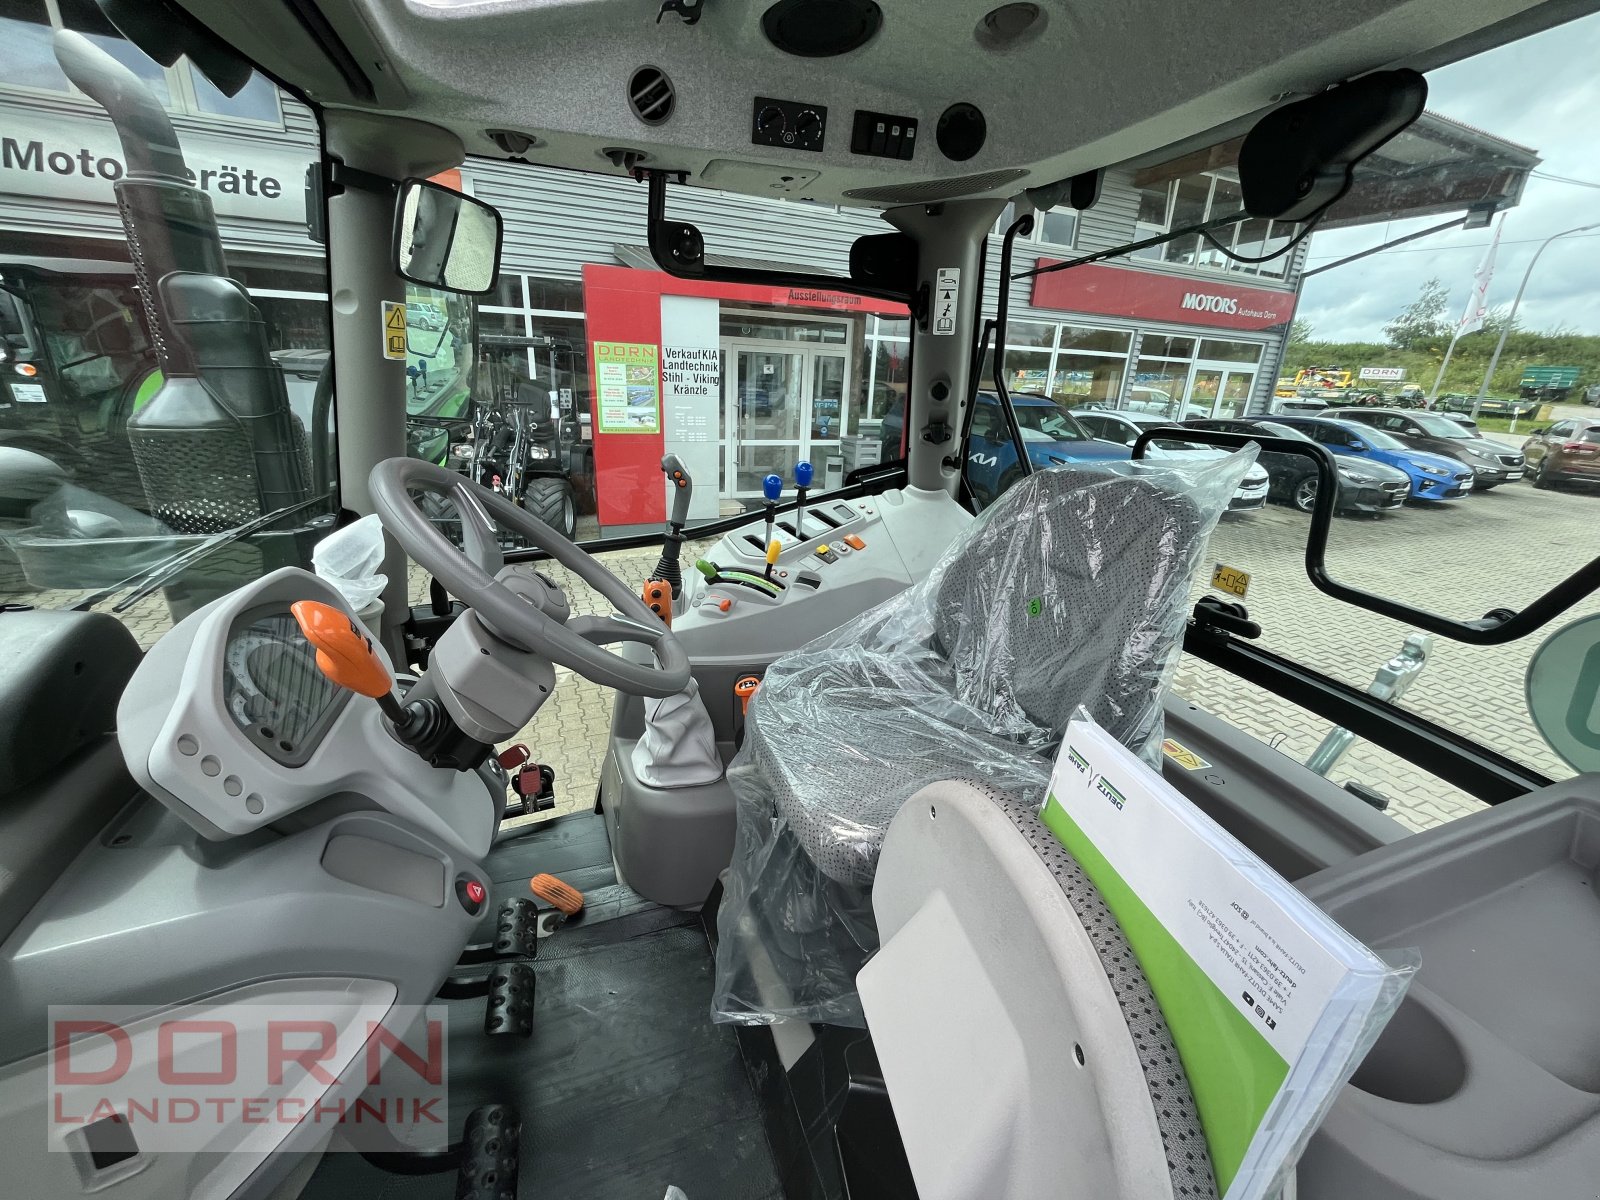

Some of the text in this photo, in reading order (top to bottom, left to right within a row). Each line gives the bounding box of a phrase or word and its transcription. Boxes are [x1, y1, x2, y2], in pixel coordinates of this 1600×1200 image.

[2, 137, 281, 199] Motoräte
[788, 289, 862, 305] Ausstellungsraum
[1181, 293, 1277, 319] MOTORS Autohaus Dorn
[599, 345, 654, 357] DORN
[665, 348, 718, 360] Verkauf KIA
[662, 359, 718, 372] Landtechnik
[1363, 368, 1399, 376] DORN
[662, 371, 683, 383] Stihl
[693, 373, 720, 387] Viking
[673, 384, 708, 396] Kränzle
[1068, 754, 1124, 810] DEUTZ FAHR
[1229, 900, 1242, 913] SDF
[1218, 945, 1235, 963] ITALIA
[1274, 943, 1306, 974] DEUTZ-FAHR
[1253, 944, 1297, 989] deutz-fahr.com
[1233, 960, 1267, 996] DEUTZ-FAHR
[1265, 994, 1284, 1014] SAME
[1272, 988, 1288, 1006] Viale
